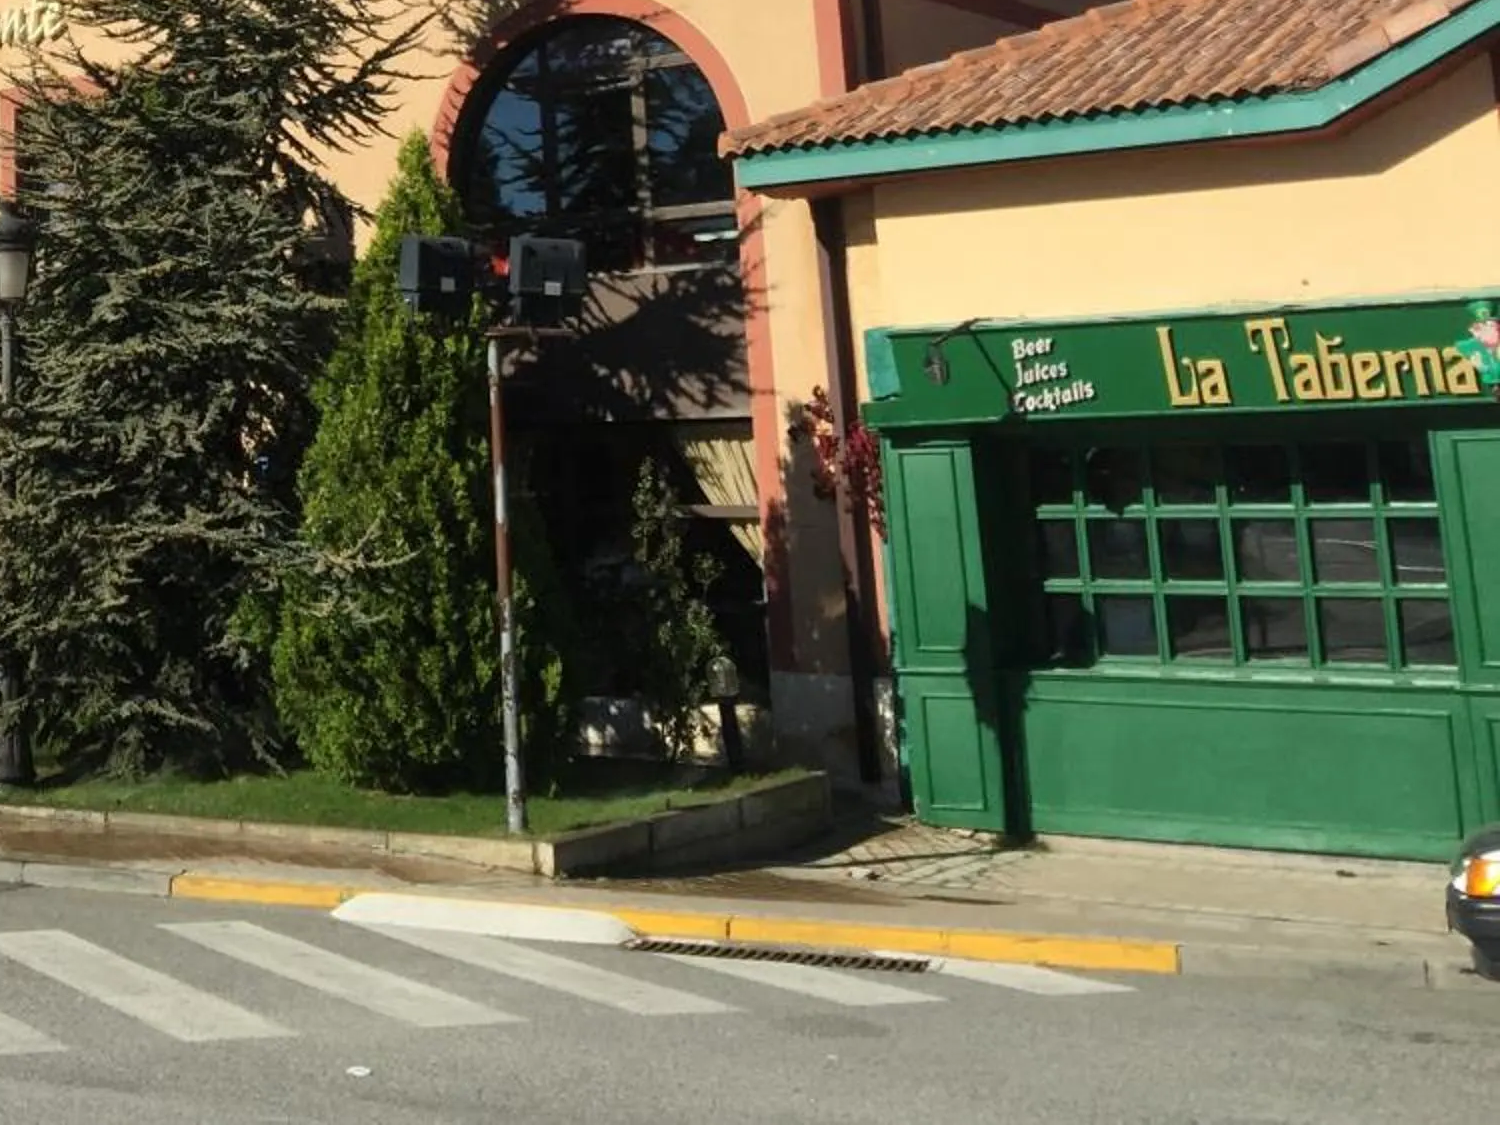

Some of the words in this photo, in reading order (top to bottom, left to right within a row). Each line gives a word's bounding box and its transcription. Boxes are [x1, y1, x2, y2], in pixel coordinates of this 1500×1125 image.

[1011, 338, 1053, 360] Beer
[1156, 326, 1231, 406] La
[1244, 317, 1479, 402] Taberna
[1015, 361, 1068, 388] Juices
[1013, 379, 1095, 412] Cocktails
